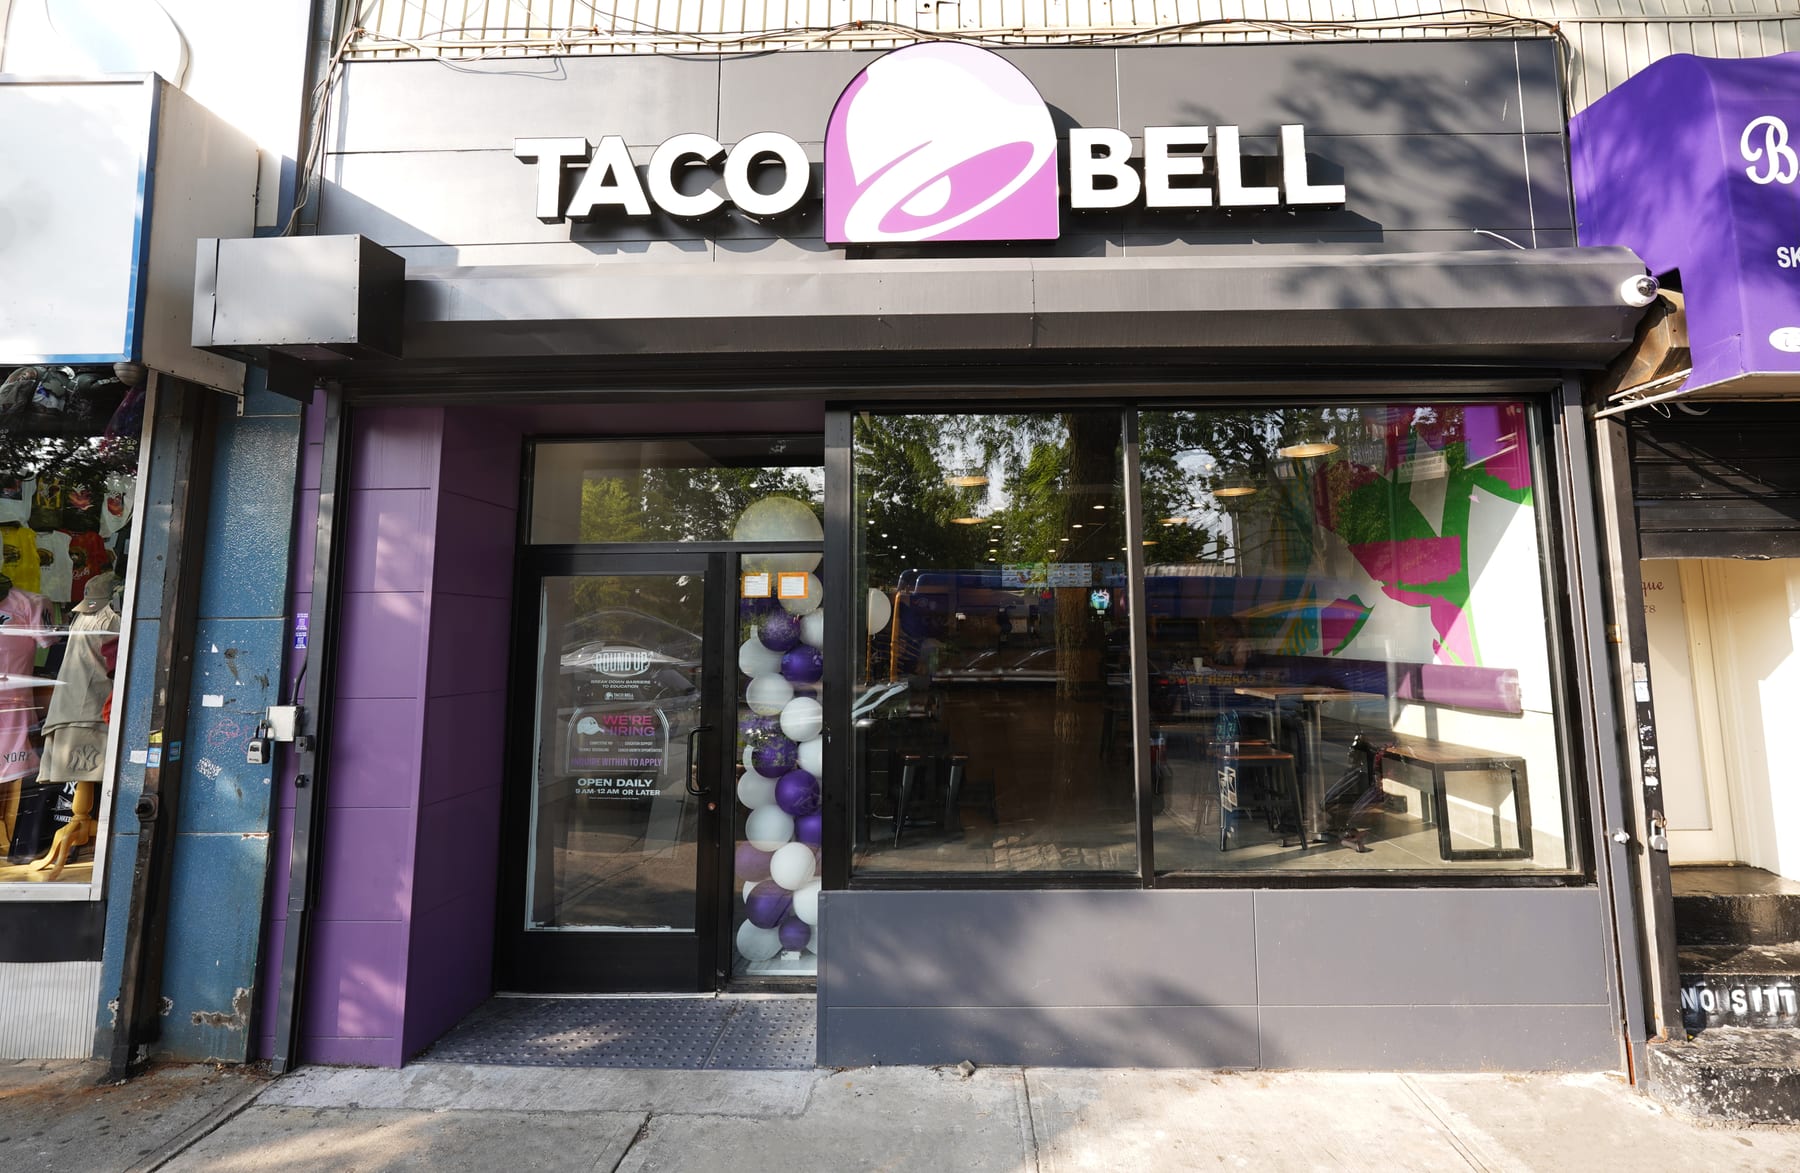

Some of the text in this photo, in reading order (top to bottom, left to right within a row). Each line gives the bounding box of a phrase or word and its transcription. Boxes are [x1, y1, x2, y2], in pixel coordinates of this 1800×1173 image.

[1740, 115, 1800, 185] B
[513, 124, 1346, 222] TACO BELL
[595, 651, 648, 672] ROUND UP
[602, 715, 652, 725] WE'RE
[602, 726, 655, 737] HIRING
[602, 757, 628, 767] WITHIN
[629, 758, 639, 767] TO
[639, 758, 662, 767] APPLY
[577, 778, 654, 787] OPEN DAILY
[1681, 986, 1715, 1012] NO
